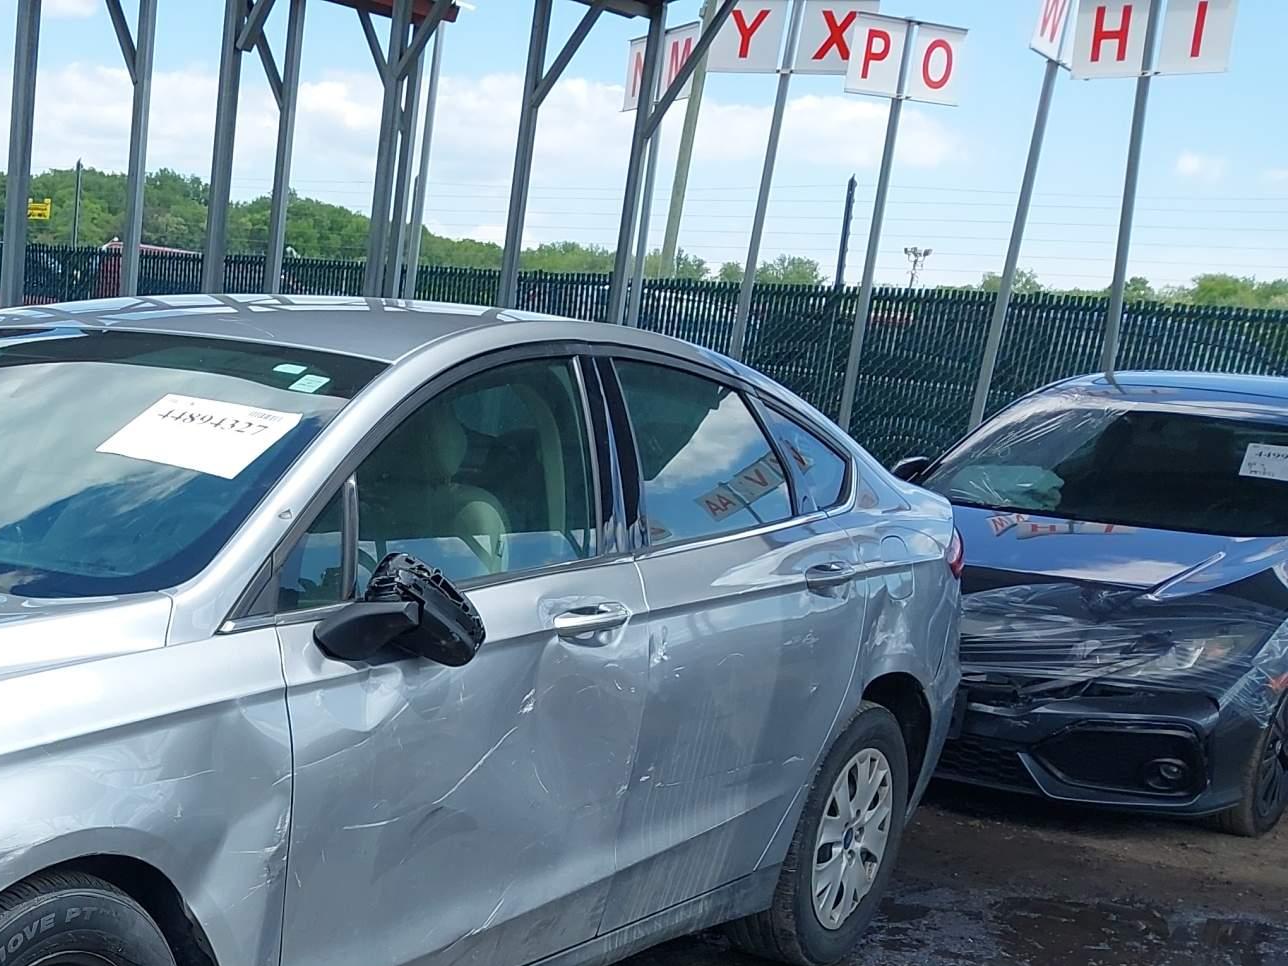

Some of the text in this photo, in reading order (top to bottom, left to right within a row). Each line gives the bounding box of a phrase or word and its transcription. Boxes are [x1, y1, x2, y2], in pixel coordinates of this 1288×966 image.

[731, 10, 857, 60] Y X
[1090, 1, 1209, 62] H I
[861, 29, 953, 89] P O
[158, 409, 269, 436] 44894327
[65, 907, 98, 923] PT
